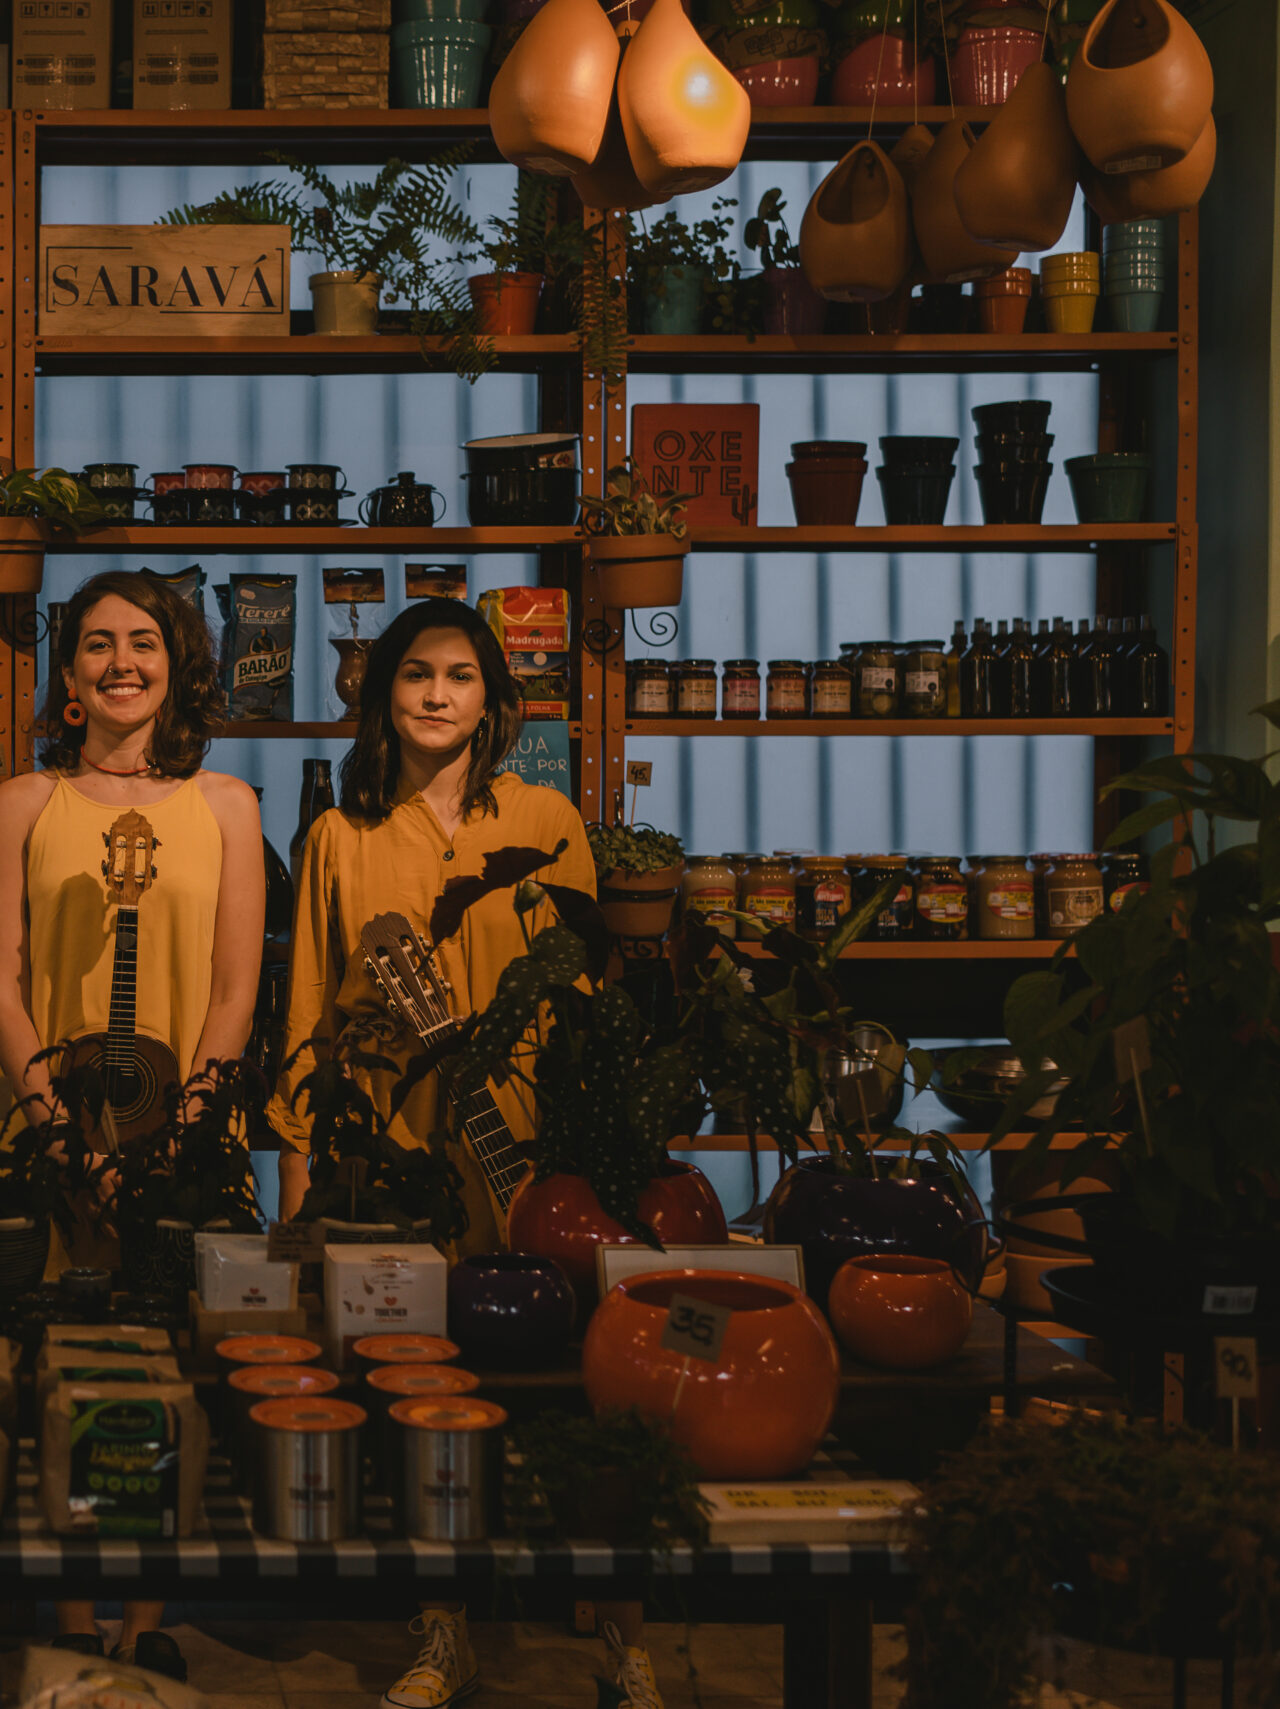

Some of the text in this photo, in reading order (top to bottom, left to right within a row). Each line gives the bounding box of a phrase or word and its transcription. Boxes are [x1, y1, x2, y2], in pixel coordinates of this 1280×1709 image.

[51, 254, 275, 308] SARAVÁ
[652, 430, 742, 462] OXE
[652, 465, 742, 497] NTE
[506, 636, 563, 647] Madrugada
[238, 653, 287, 677] BARÃO
[538, 759, 568, 772] POR
